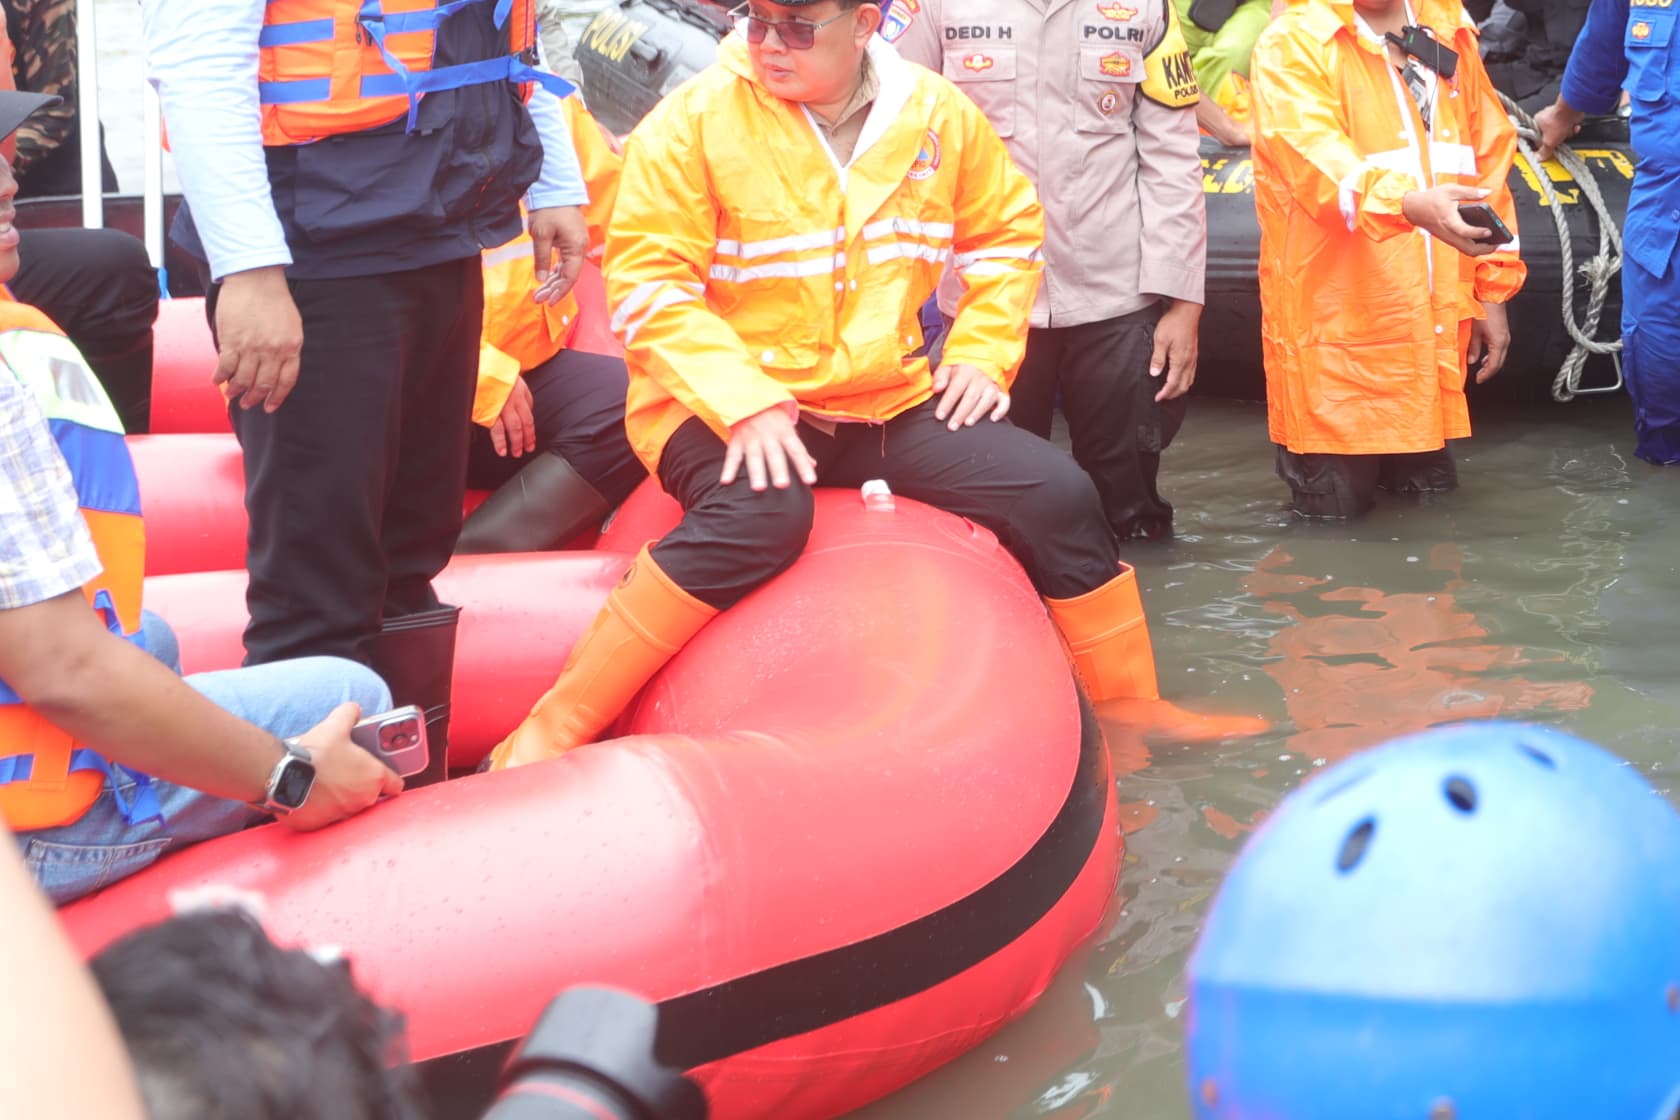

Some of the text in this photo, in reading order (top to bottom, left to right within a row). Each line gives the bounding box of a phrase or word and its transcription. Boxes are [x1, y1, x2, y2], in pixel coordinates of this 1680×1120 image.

[945, 26, 1012, 41] DEDI H
[1083, 25, 1144, 42] POLRI
